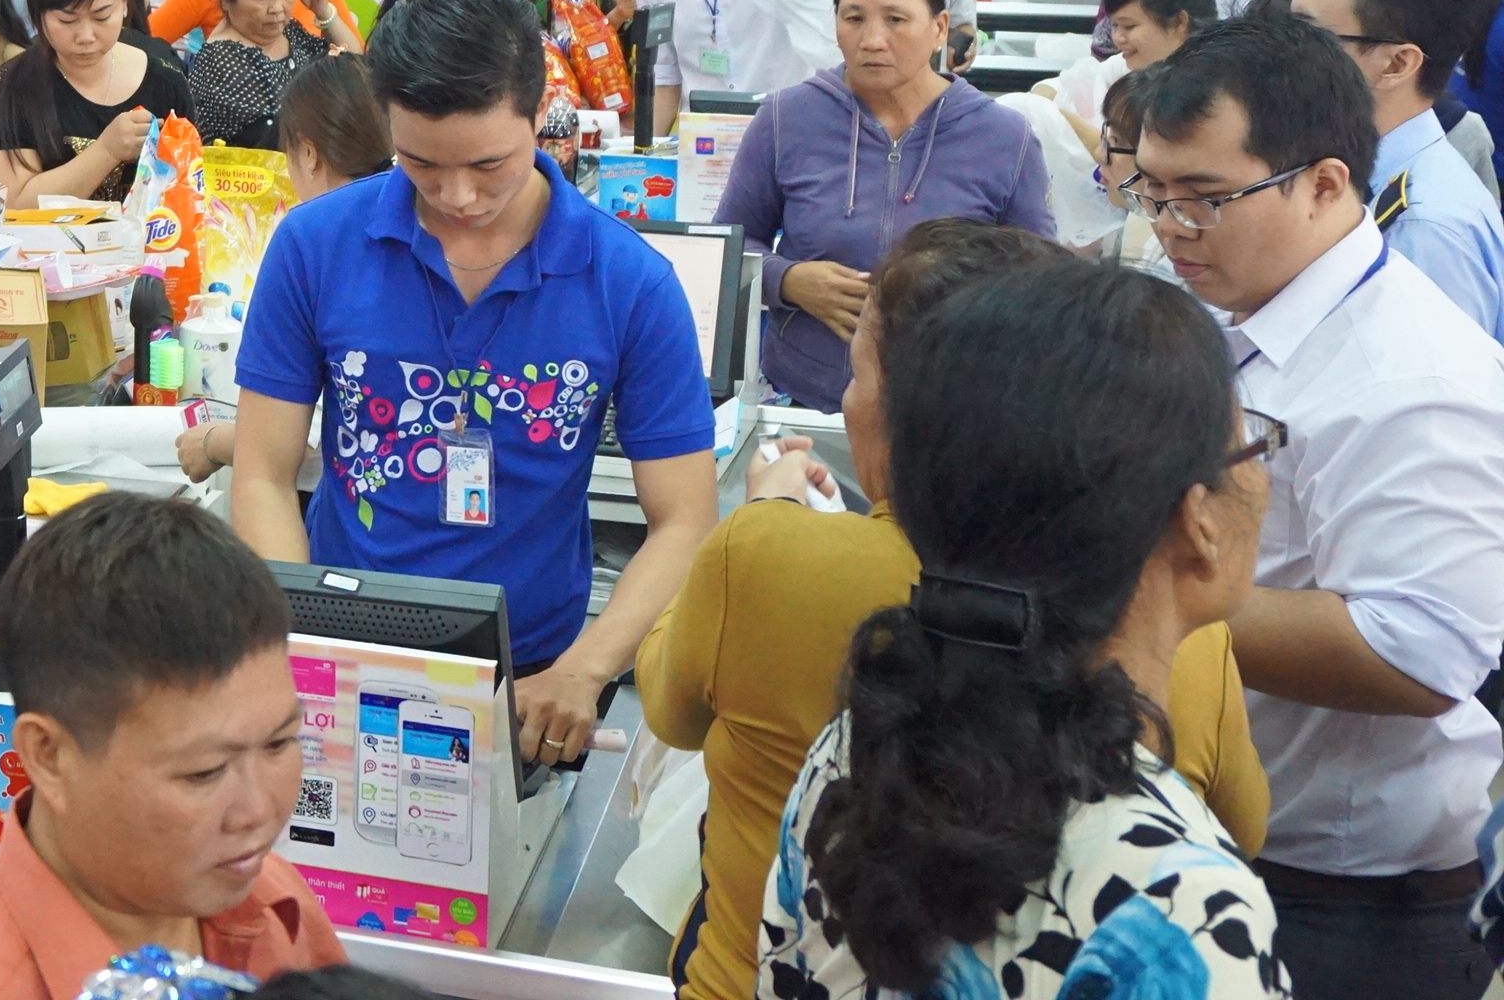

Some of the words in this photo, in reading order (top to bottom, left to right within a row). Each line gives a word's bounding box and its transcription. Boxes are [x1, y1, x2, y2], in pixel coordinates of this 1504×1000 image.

[214, 168, 230, 178] Siêu
[232, 169, 246, 179] tiết
[247, 170, 265, 181] kiệm
[214, 179, 263, 195] 30.500đ
[146, 218, 176, 245] Tide
[193, 339, 219, 352] Dove
[304, 711, 336, 731] LỢI
[308, 878, 326, 889] thân
[327, 880, 346, 892] thiết
